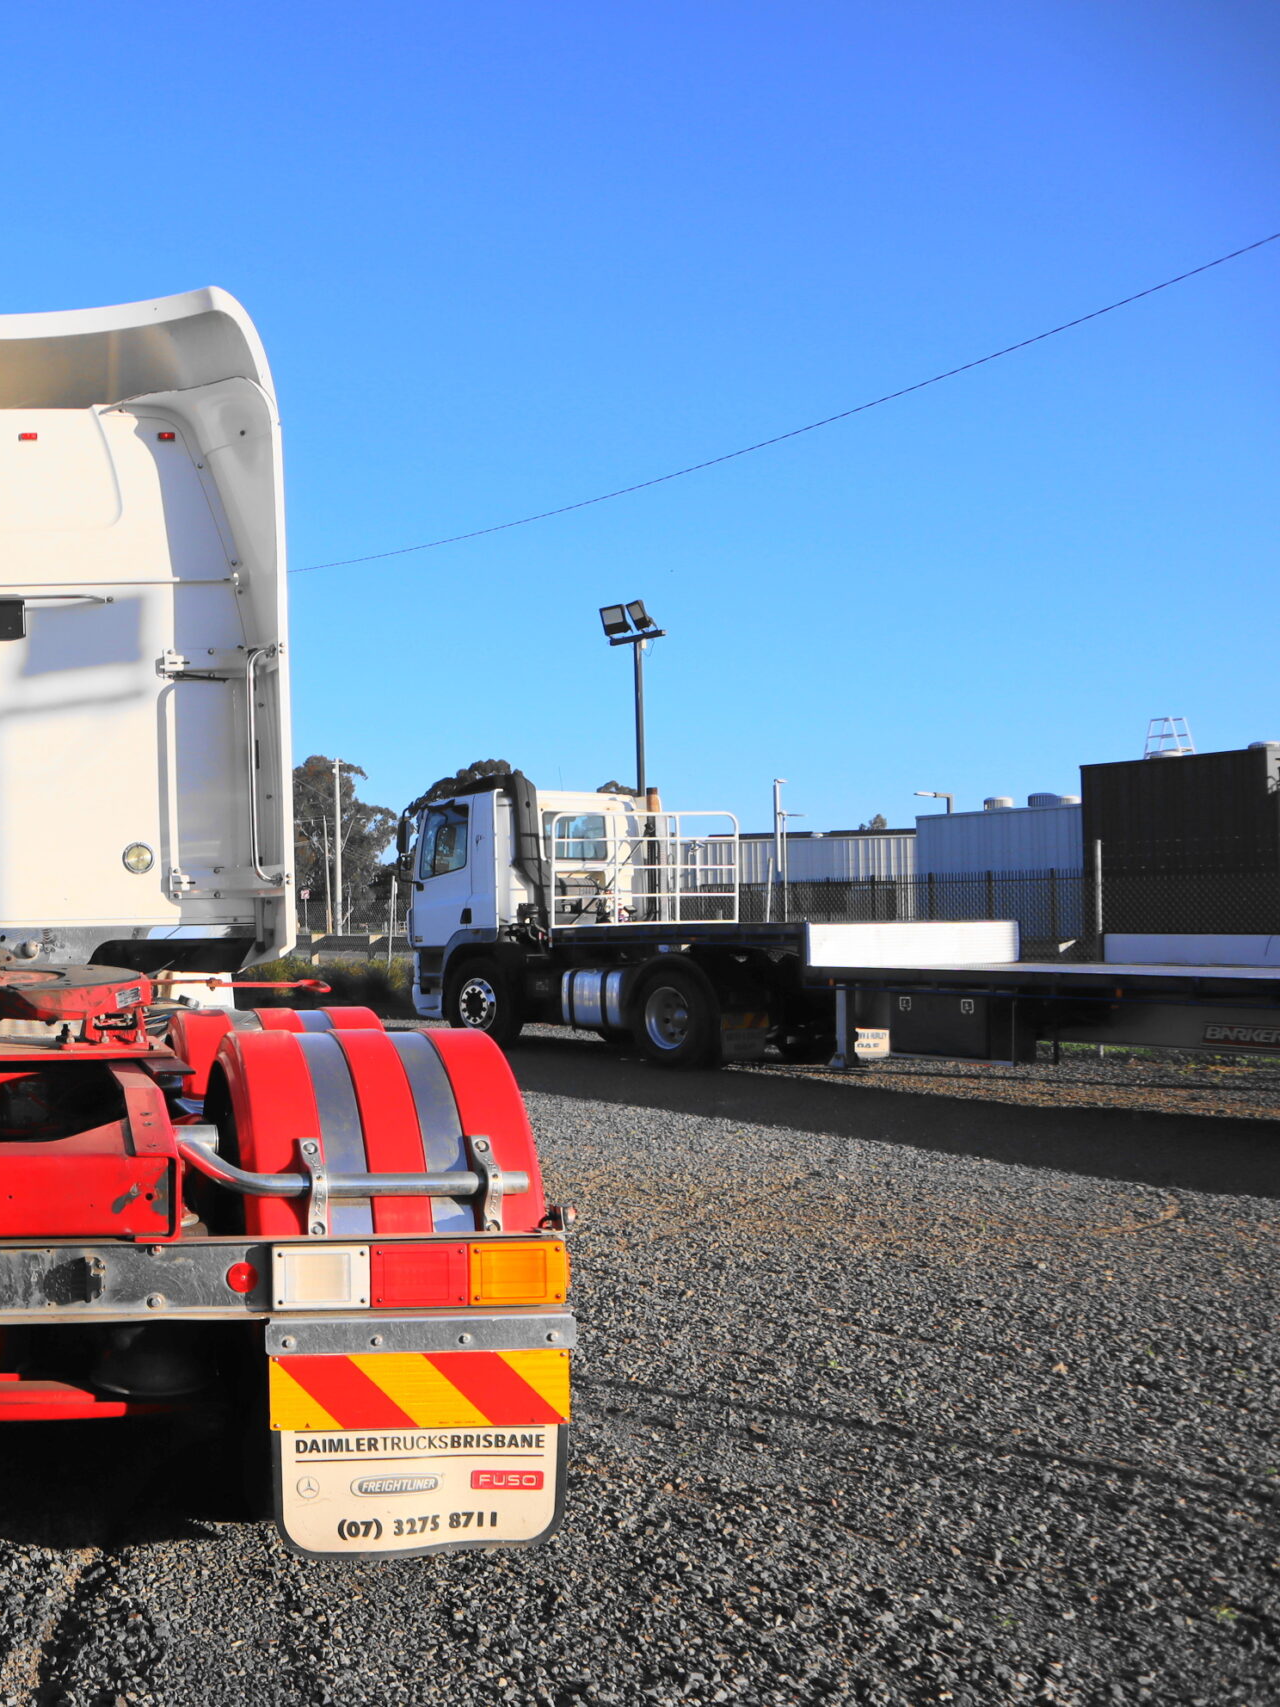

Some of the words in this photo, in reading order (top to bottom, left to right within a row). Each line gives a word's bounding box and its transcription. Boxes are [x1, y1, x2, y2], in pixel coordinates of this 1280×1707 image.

[361, 1477, 436, 1493] FREIGHTLINER
[479, 1474, 537, 1486] FUSO
[337, 1518, 382, 1540] (07)
[393, 1514, 440, 1536] 3275
[448, 1511, 498, 1528] 8711
